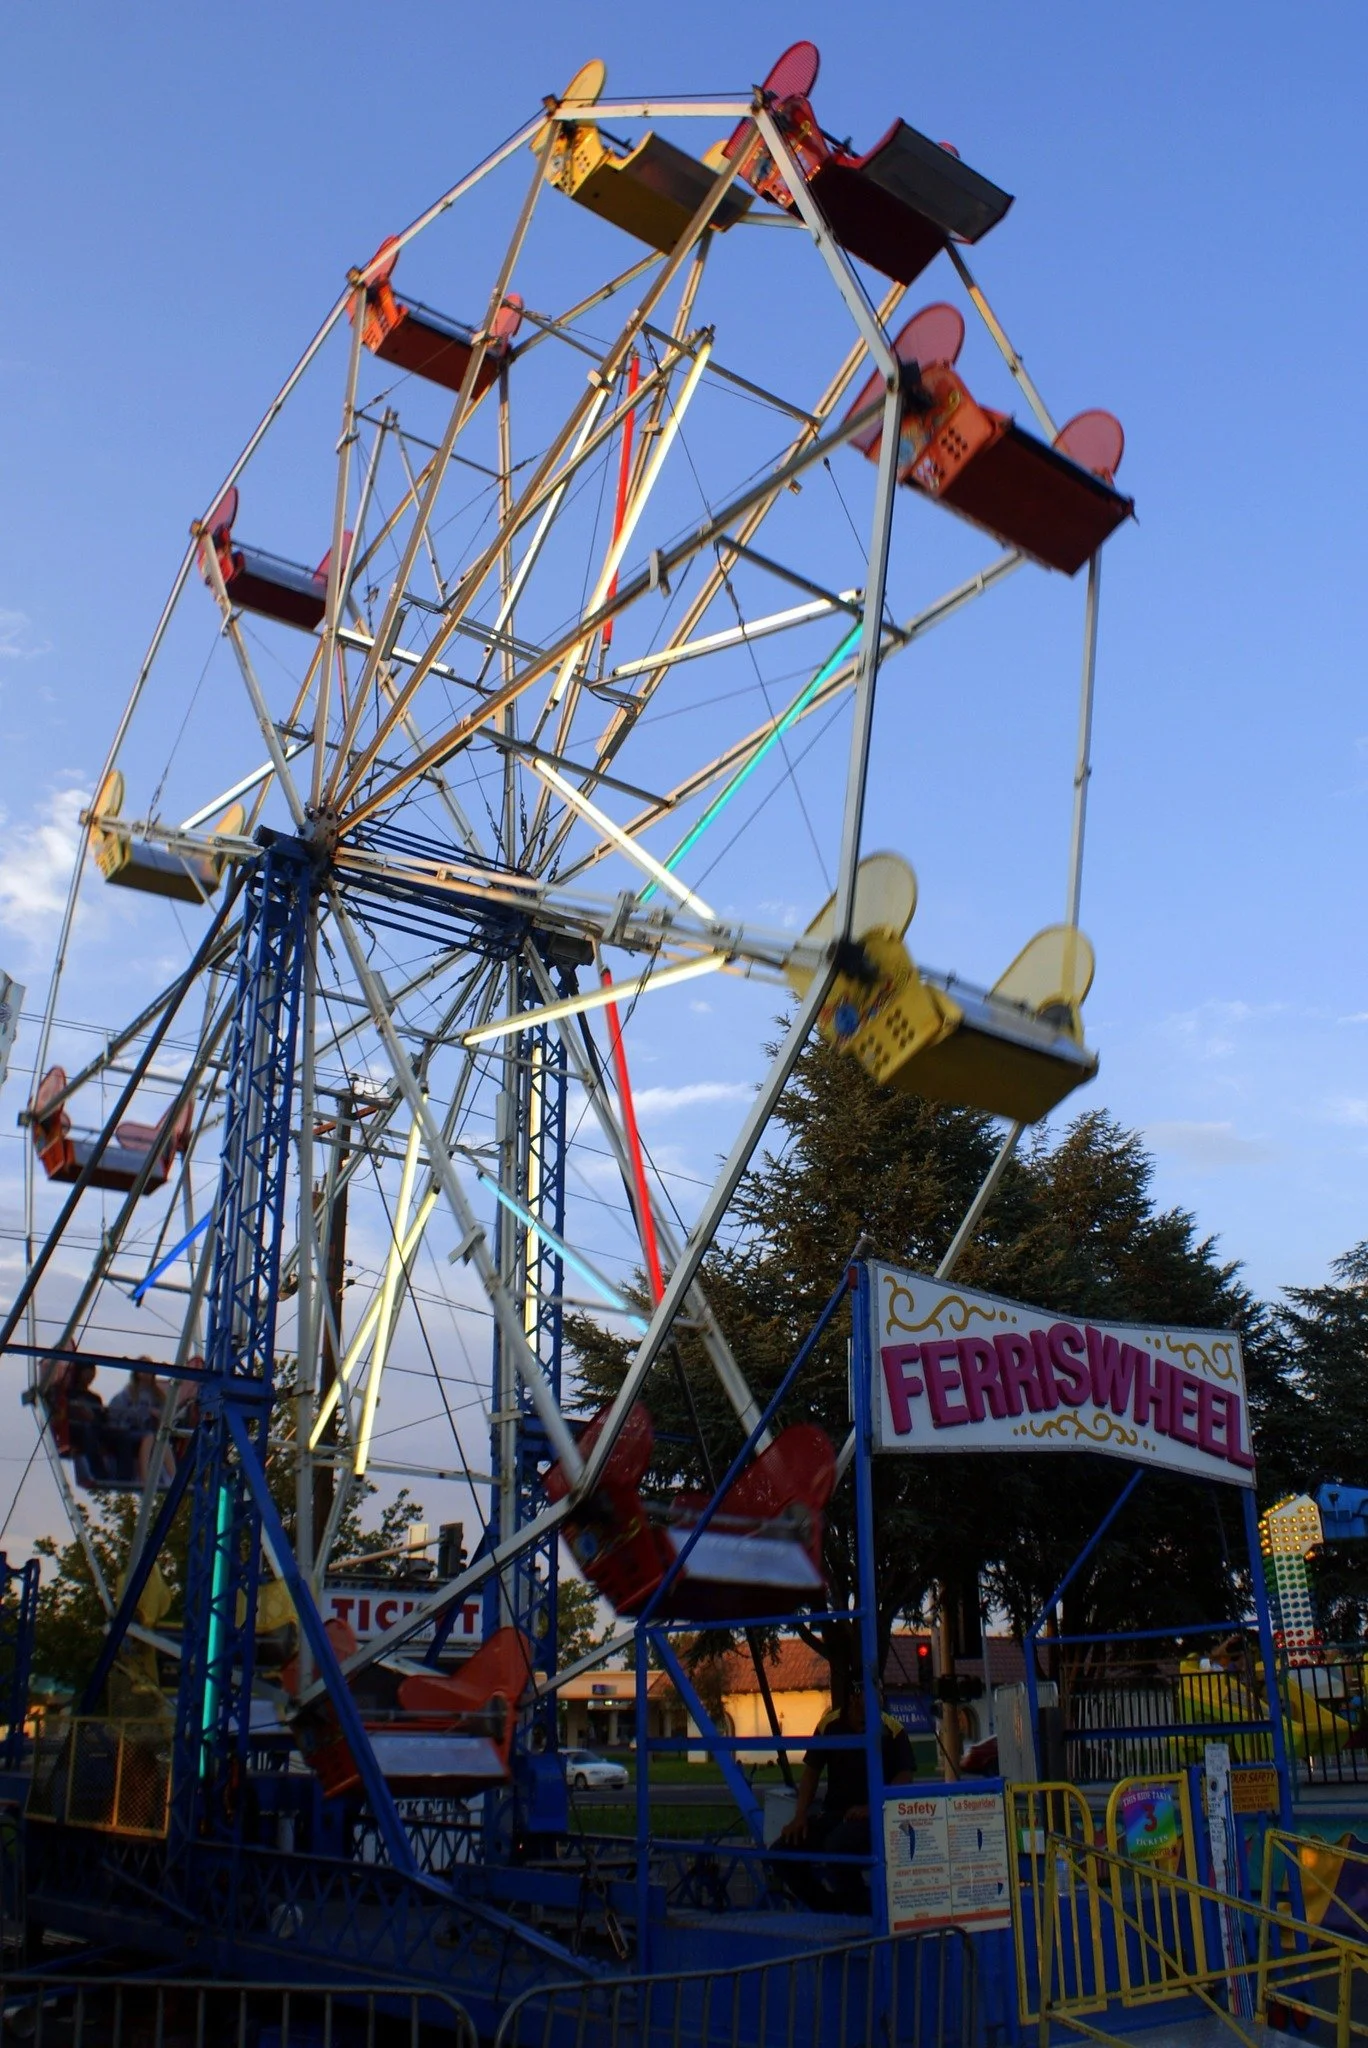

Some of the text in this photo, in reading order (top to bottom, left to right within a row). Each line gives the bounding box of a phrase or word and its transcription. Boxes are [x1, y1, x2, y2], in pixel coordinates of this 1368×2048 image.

[331, 1598, 479, 1634] TICT
[954, 1799, 996, 1811] La Seguridad
[1123, 1794, 1137, 1807] THIS
[1137, 1791, 1151, 1802] RIDE
[898, 1802, 936, 1816] Safety
[1144, 1804, 1157, 1832] 3
[1135, 1834, 1169, 1846] TICKETS
